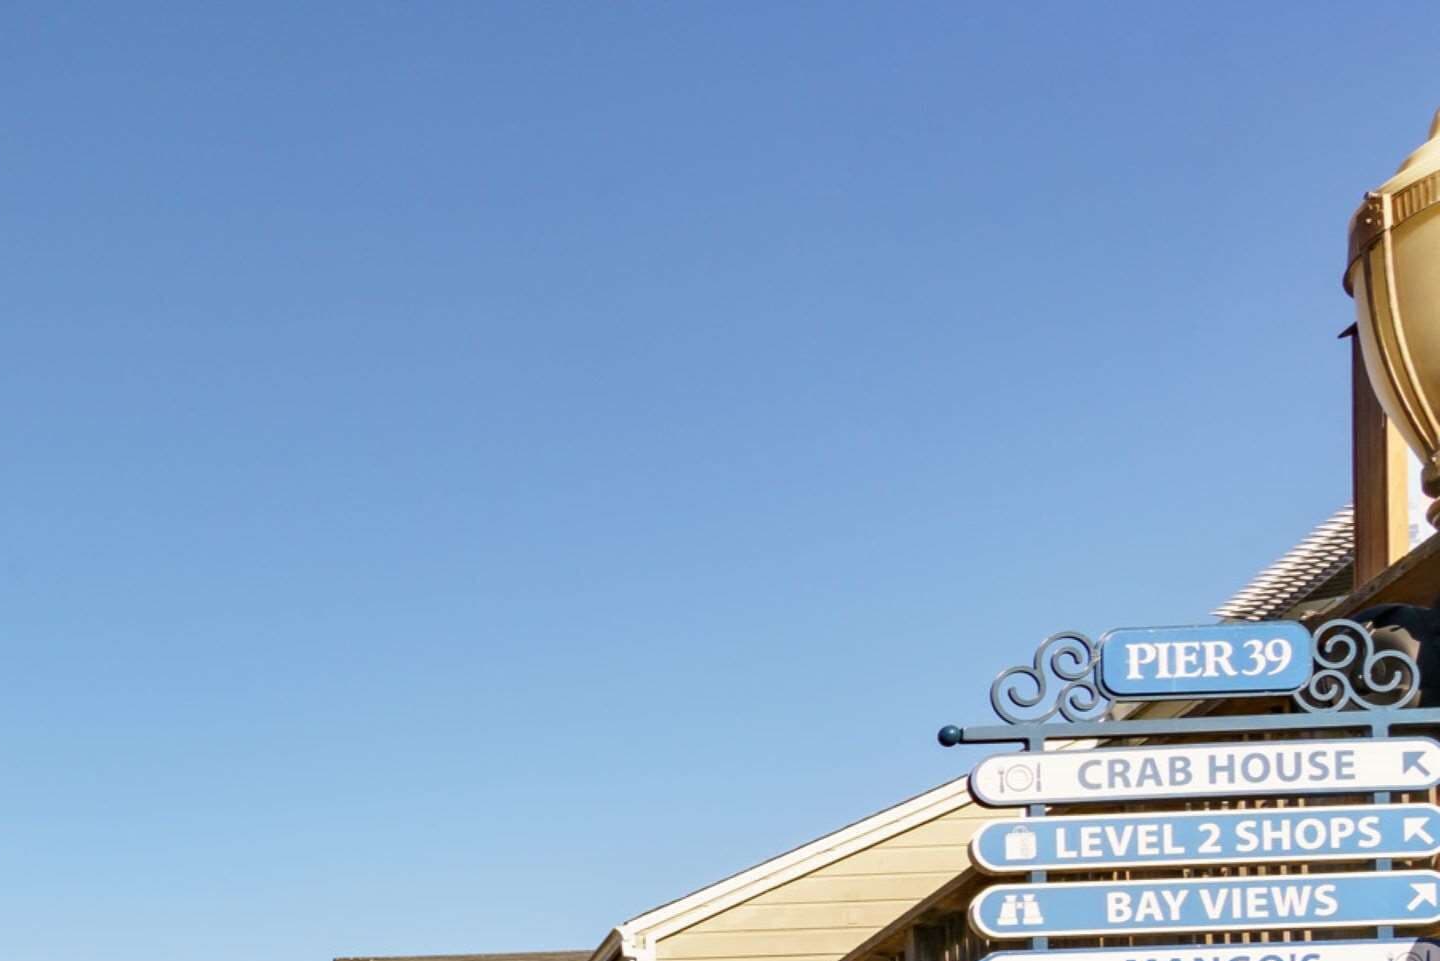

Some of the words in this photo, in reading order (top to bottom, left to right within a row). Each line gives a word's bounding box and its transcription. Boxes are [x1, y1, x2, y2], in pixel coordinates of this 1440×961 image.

[1125, 642, 1237, 680] PIER
[1241, 638, 1293, 676] 39
[1077, 753, 1193, 791] CRAB
[1208, 749, 1357, 786] HOUSE
[1056, 822, 1186, 859] LEVEL
[1197, 821, 1223, 854] 2
[1234, 815, 1382, 852] SHOPS
[1106, 889, 1189, 924] BAY
[1199, 883, 1339, 920] VIEWS
